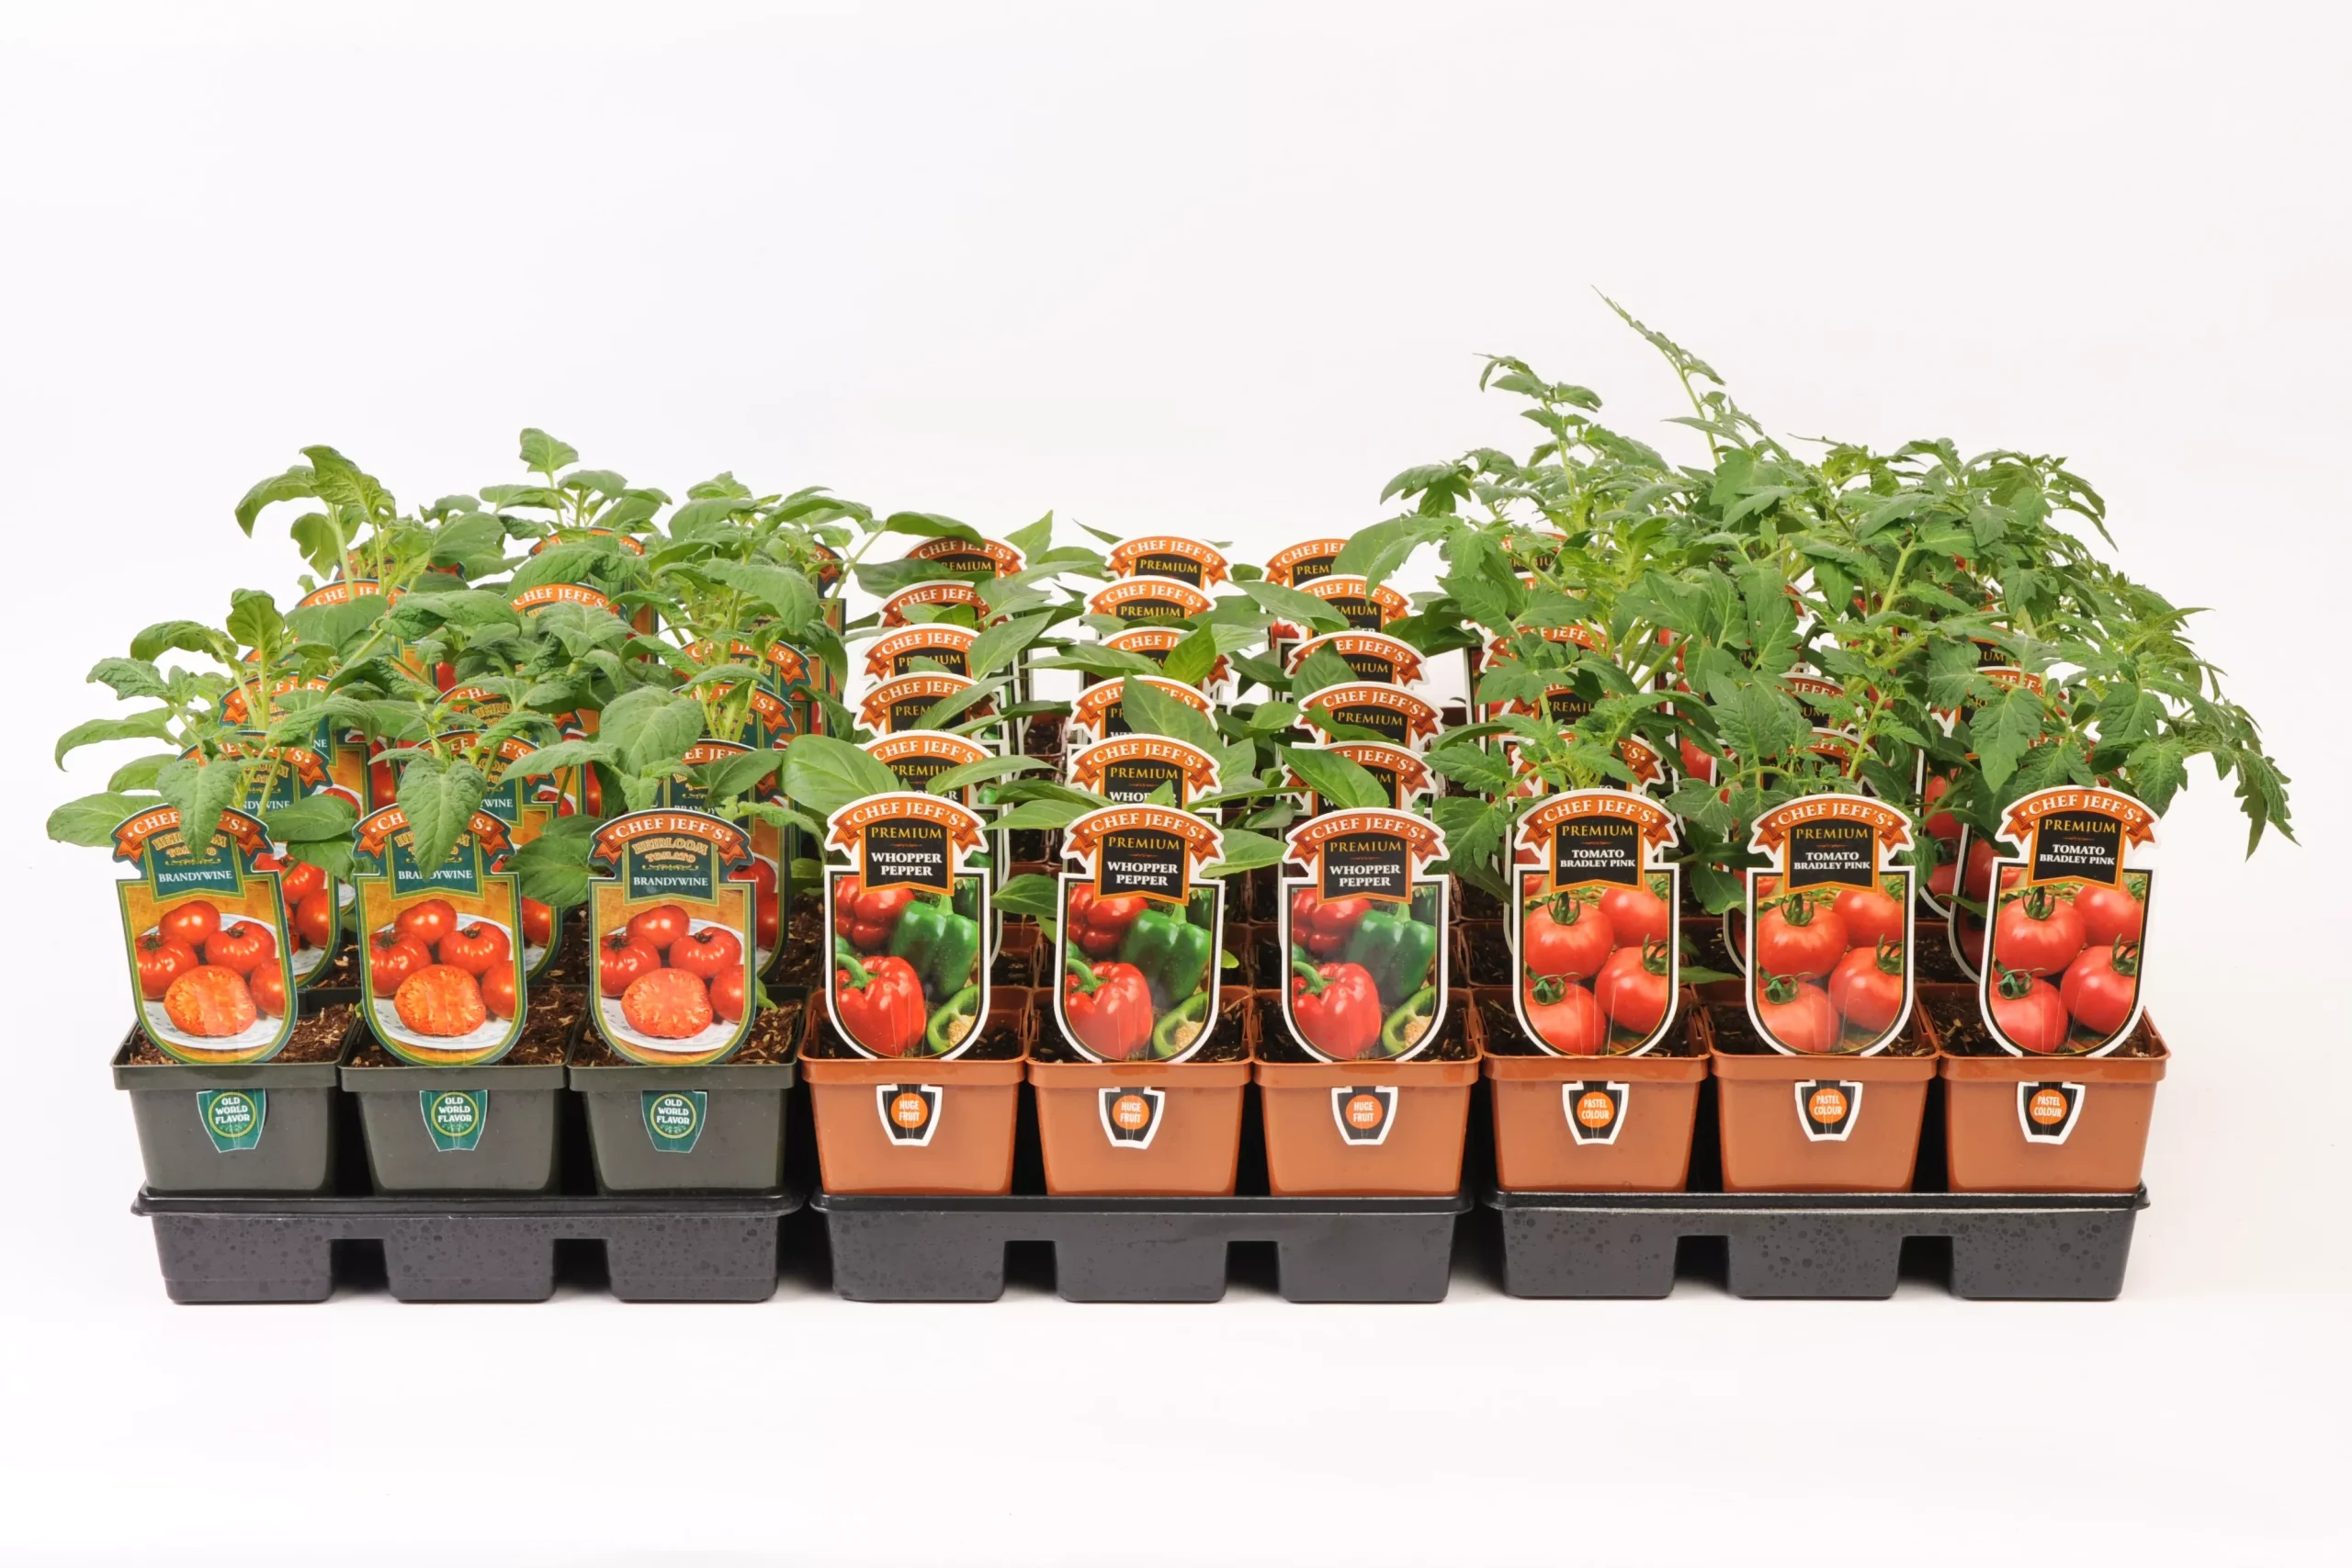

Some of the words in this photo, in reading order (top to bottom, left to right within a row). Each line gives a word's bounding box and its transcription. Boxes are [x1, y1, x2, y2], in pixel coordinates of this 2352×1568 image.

[919, 540, 957, 559] CHEF
[1126, 539, 1167, 556] CHEF
[1170, 540, 1212, 564] JEFF'S
[1281, 543, 1320, 564] CHEF
[1139, 558, 1198, 574] PREMIUM
[1296, 564, 1330, 575] PREM
[1105, 583, 1148, 603] CHEF
[1150, 583, 1197, 606] JEFF'S
[1306, 583, 1344, 598] HEF
[314, 588, 349, 606] CHE
[514, 587, 553, 605] CHEF
[558, 588, 605, 607] JEFF'S
[898, 589, 937, 607] CHEF
[1120, 605, 1181, 617] PREMIUM
[881, 633, 922, 655] CHEF
[1119, 635, 1162, 651] CHEF
[1358, 639, 1405, 662] JEFF'S
[1351, 662, 1389, 673] MIUM
[878, 682, 922, 703] CHEF
[926, 681, 963, 695] JEFF
[1322, 690, 1367, 707] CHEF
[1371, 691, 1421, 715] JEFF'S
[896, 705, 931, 716] PREM
[1338, 711, 1403, 726] PREMIUM
[874, 740, 918, 761] CHEF
[923, 740, 976, 763] JEFF'S
[1093, 743, 1139, 764] CHEF
[1145, 743, 1197, 766] JEFF'S
[1357, 750, 1409, 771] JEFF'S
[1110, 766, 1179, 779] PREMIUM
[1544, 799, 1592, 822] CHEF
[1597, 799, 1653, 822] JEFF'S
[2029, 794, 2078, 816] CHEF
[2083, 794, 2137, 820] JEFF'S
[853, 801, 900, 824] CHEF
[905, 801, 960, 826] JEFF'S
[1778, 803, 1826, 825] CHEF
[1832, 803, 1887, 825] JEFF'S
[133, 811, 180, 835] CHEF
[615, 818, 664, 839] CHEF
[670, 818, 725, 840] JEFF'S
[1091, 813, 1139, 833] CHEF
[1145, 813, 1200, 839] JEFF'S
[1312, 818, 1360, 839] CHEF
[1365, 818, 1420, 839] JEFF'S
[2044, 818, 2116, 834] PREMIUM
[870, 827, 943, 840] PREMIUM
[1561, 825, 1634, 837] PREMIUM
[1795, 828, 1869, 840] PREMIUM
[631, 837, 708, 856] HEIRLOOM
[1108, 837, 1181, 850] PREMIUM
[1329, 840, 1402, 852] PREMIUM
[2052, 843, 2105, 855] TOMATO
[645, 851, 696, 863] TOMATO
[871, 852, 943, 863] WHOPPER
[1572, 849, 1624, 859] TOMATO
[1805, 852, 1860, 861] TOMATO
[2039, 853, 2087, 864] BRADLEY
[2089, 856, 2115, 865] PINK
[1107, 861, 1179, 874] WHOPPER
[1329, 863, 1401, 875] WHOPPER
[1560, 859, 1608, 868] BRADLEY
[1610, 859, 1636, 868] PINK
[1793, 862, 1843, 870] BRADLEY
[1844, 861, 1871, 870] PINK
[880, 865, 933, 876] PEPPER
[158, 870, 233, 884] BRANDYWINE
[633, 876, 709, 887] BRANDYWINE
[1115, 874, 1168, 886] PEPPER
[1339, 876, 1391, 887] PEPPER
[220, 1096, 241, 1106] OLD
[445, 1096, 464, 1105] OLD
[664, 1098, 684, 1107] OLD
[899, 1100, 920, 1111] HUGE
[1353, 1100, 1374, 1111] HUGE
[1583, 1099, 1607, 1109] PASTEL
[1815, 1095, 1840, 1105] PASTEL
[2037, 1096, 2061, 1107] PASTEL
[214, 1106, 248, 1116] WORLD
[438, 1105, 471, 1114] WORLD
[658, 1107, 690, 1116] WORLD
[1120, 1101, 1142, 1112] HUGE
[1814, 1105, 1843, 1116] COLOUR
[2033, 1107, 2063, 1118] COLOUR
[214, 1114, 251, 1125] FLAVOR
[437, 1114, 472, 1123] FLAVOR
[656, 1115, 691, 1125] FLAVOR
[899, 1111, 920, 1122] FRUIT
[1119, 1113, 1142, 1123] FRUIT
[1352, 1112, 1374, 1122] FRUIT
[1581, 1110, 1610, 1120] COLOUR
